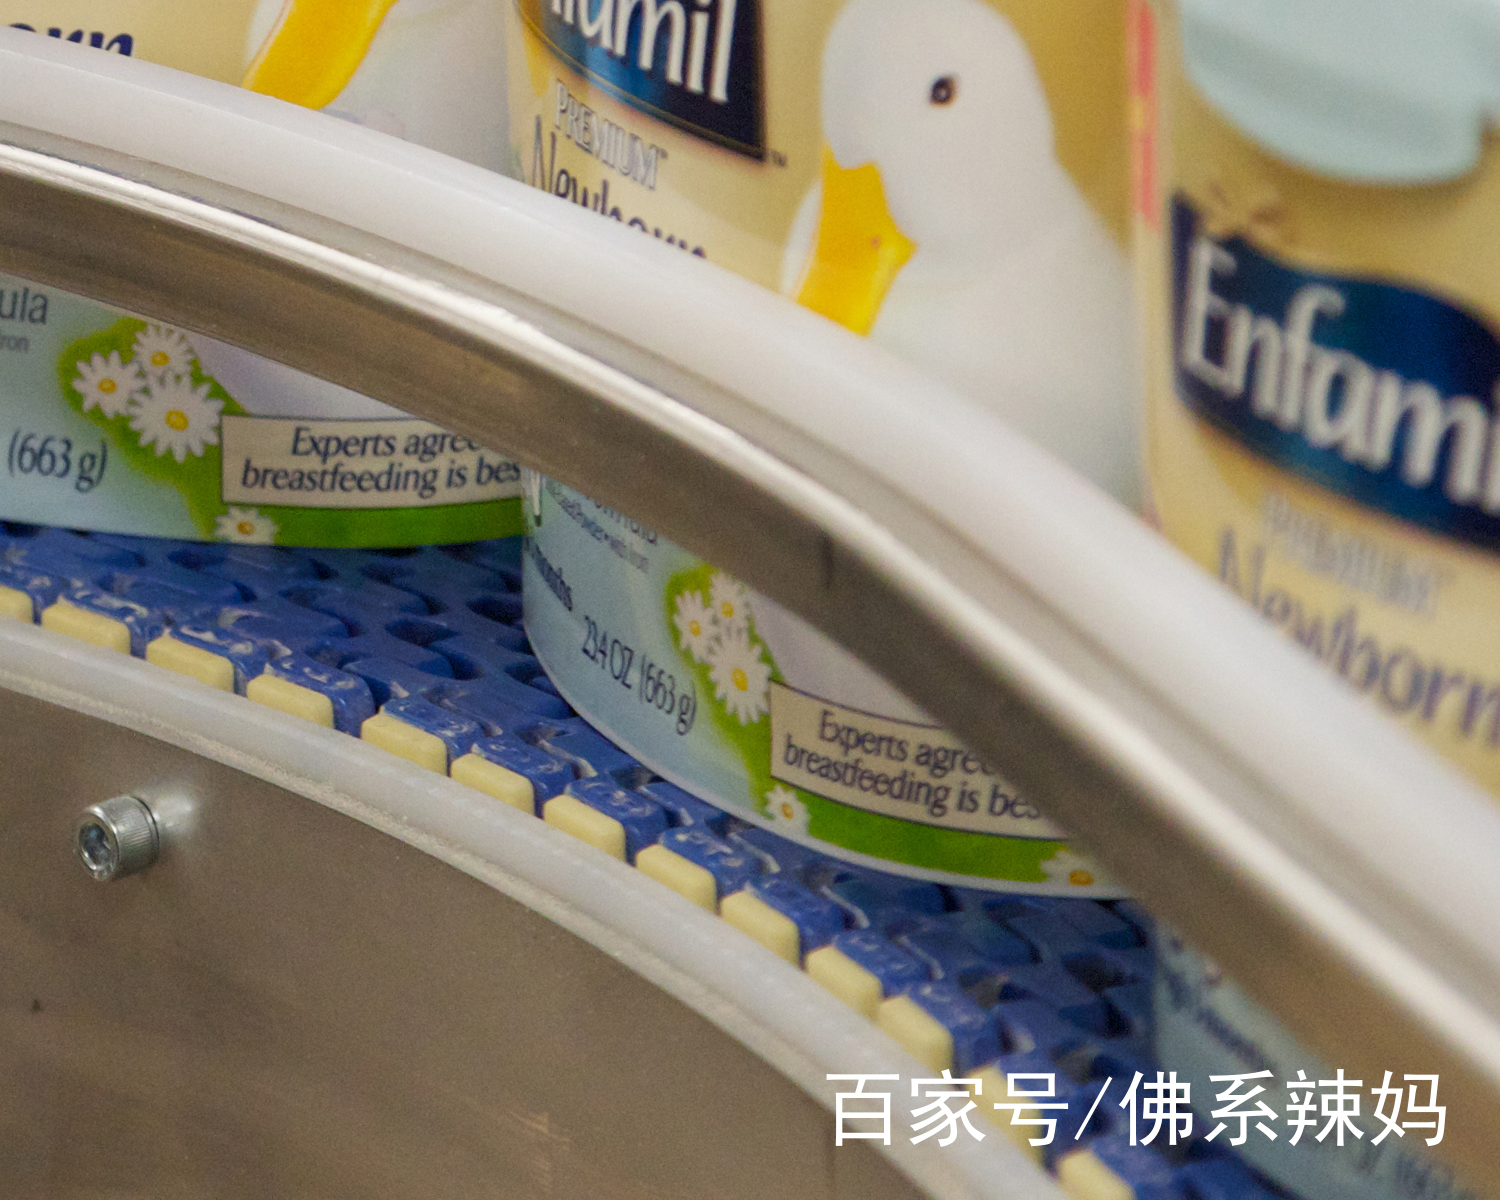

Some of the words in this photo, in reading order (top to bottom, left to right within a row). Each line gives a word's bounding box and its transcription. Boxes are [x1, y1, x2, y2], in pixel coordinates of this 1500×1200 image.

[555, 78, 657, 191] PREMIUM
[7, 428, 73, 479] (663
[74, 440, 108, 493] g)
[291, 426, 396, 464] Experts
[241, 459, 439, 500] breastfeeding
[444, 462, 468, 486] is
[475, 456, 522, 487] bes
[609, 637, 635, 691] OZ
[676, 678, 698, 737] g)
[819, 708, 910, 762] Experts
[784, 732, 951, 818] breastfeeding
[956, 779, 981, 813] is
